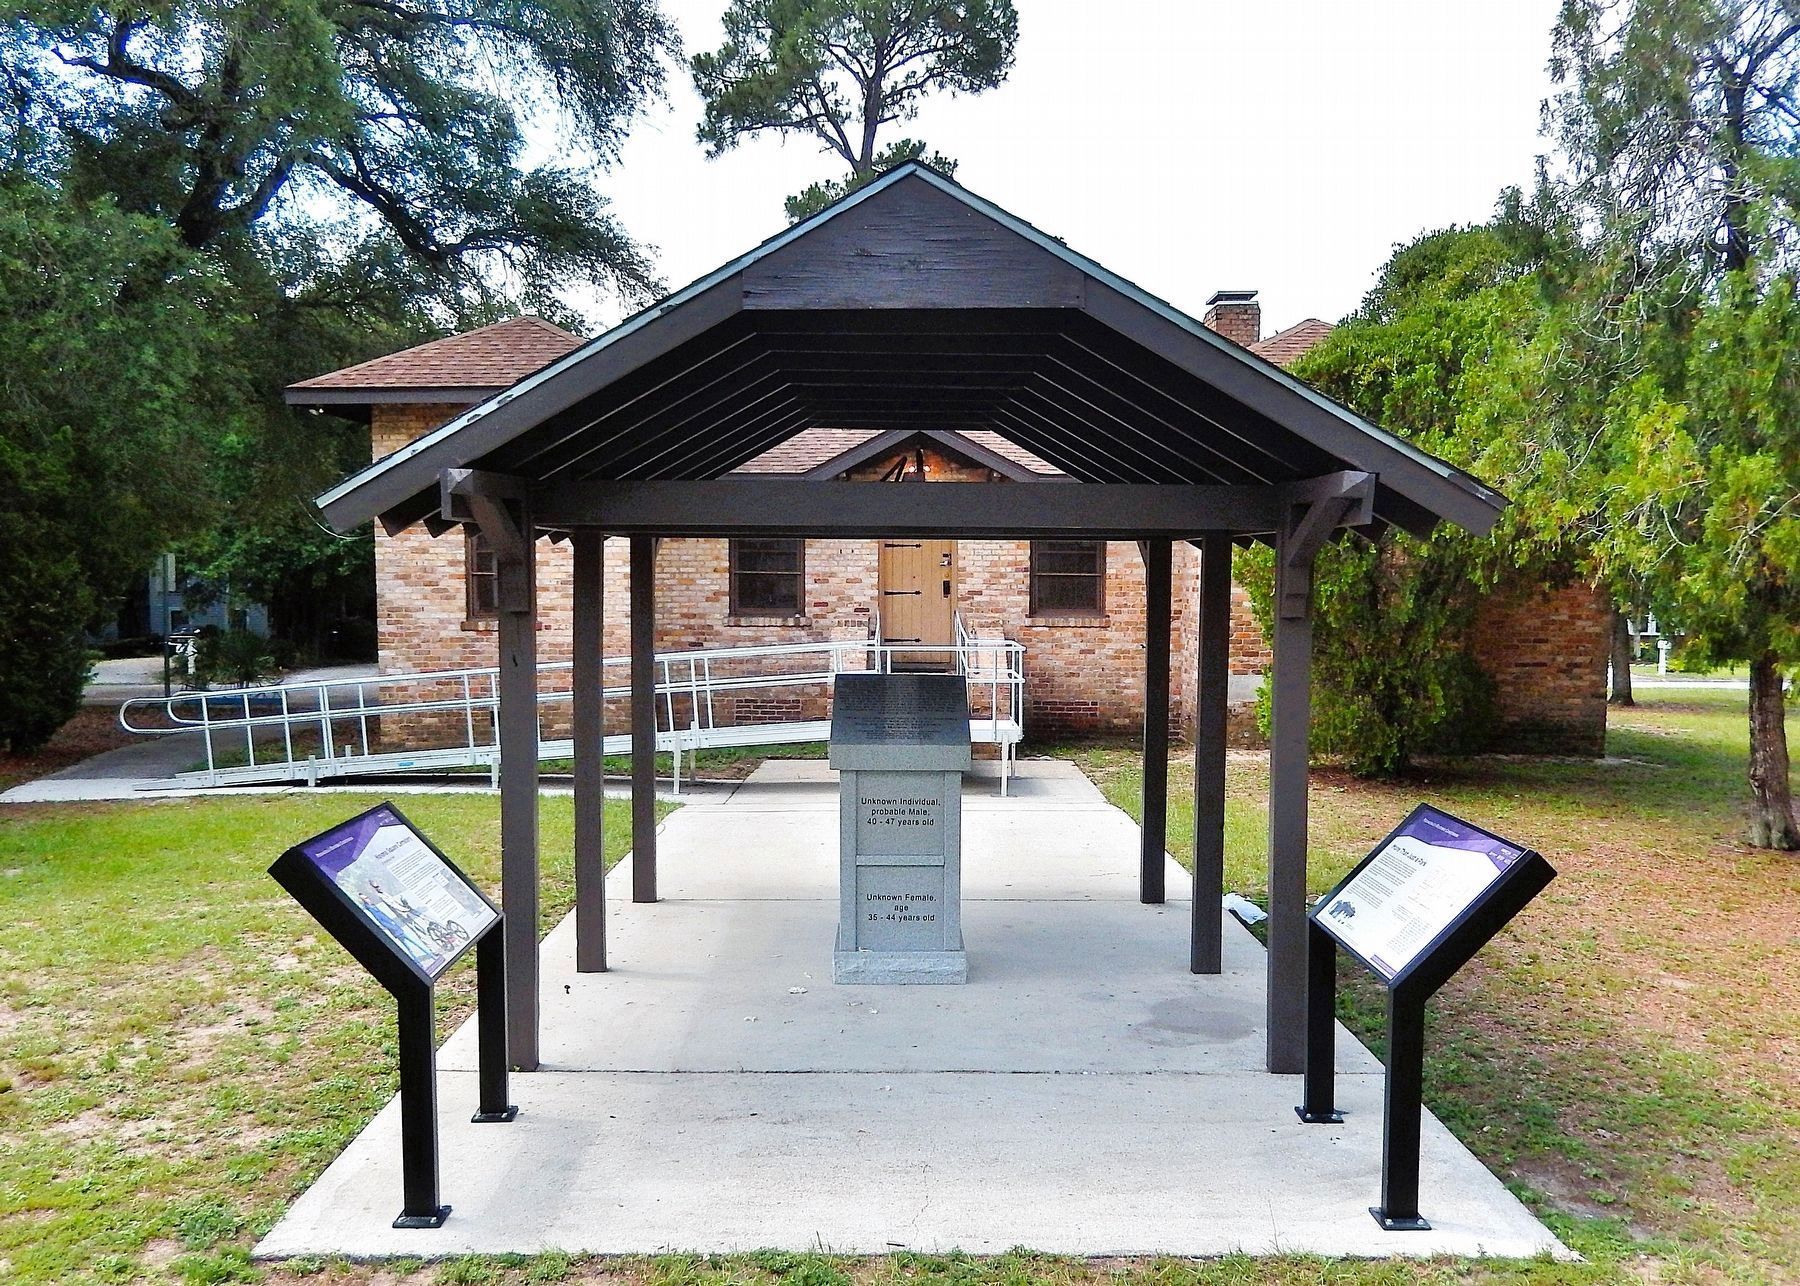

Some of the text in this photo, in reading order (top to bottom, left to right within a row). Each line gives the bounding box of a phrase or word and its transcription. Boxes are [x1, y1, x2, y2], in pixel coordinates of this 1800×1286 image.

[861, 797, 897, 805] Unknown
[871, 808, 906, 816] probable
[867, 817, 877, 825] 40
[885, 817, 895, 825] 47
[897, 819, 920, 827] years
[922, 818, 934, 826] old
[866, 893, 903, 901] Unknown
[868, 913, 878, 921] 35
[886, 913, 896, 921] 44
